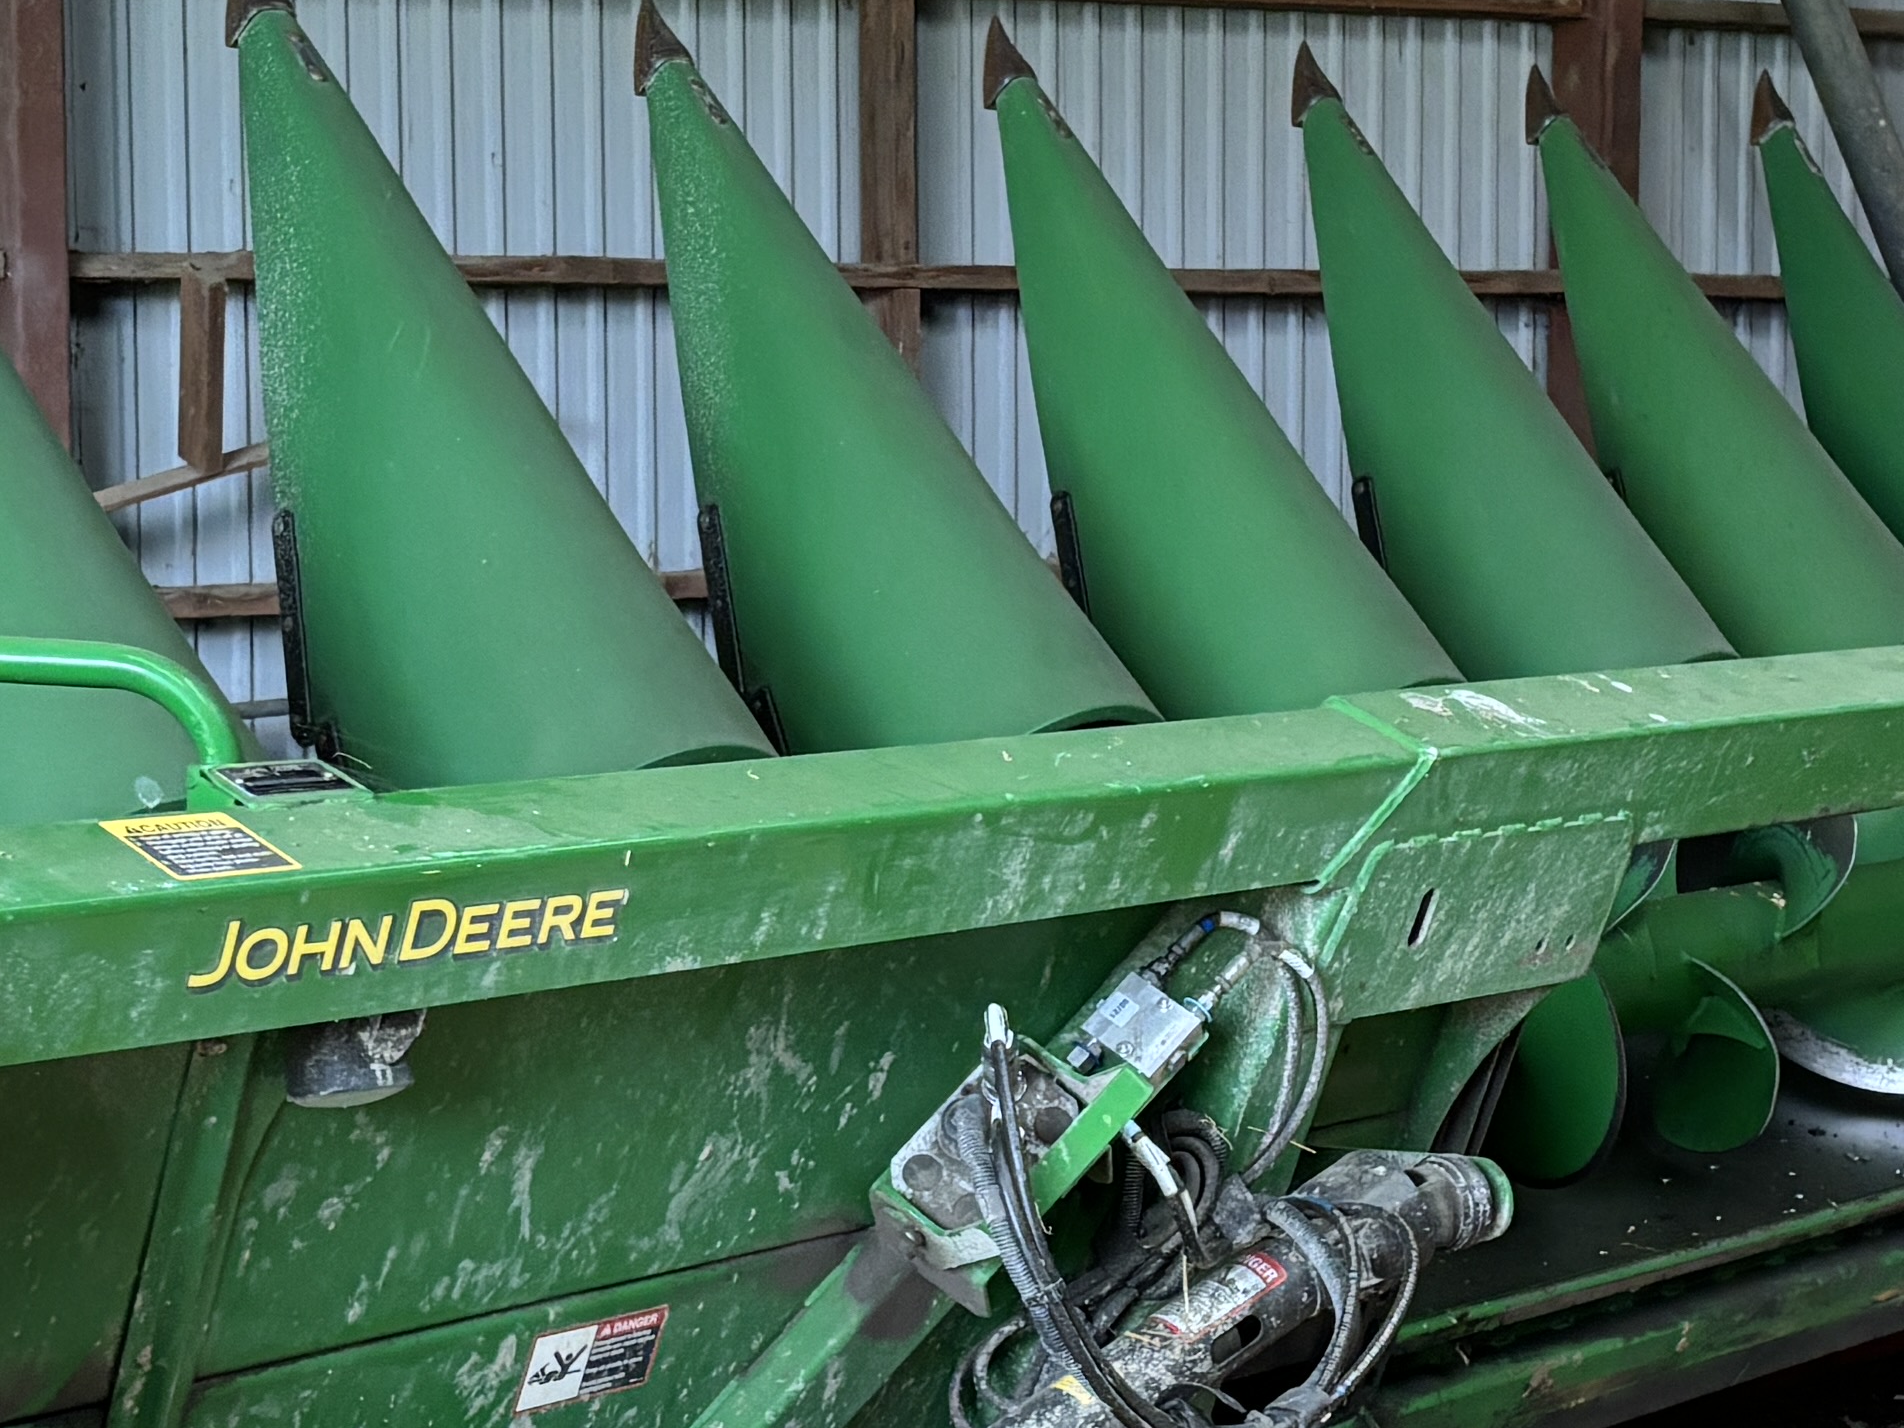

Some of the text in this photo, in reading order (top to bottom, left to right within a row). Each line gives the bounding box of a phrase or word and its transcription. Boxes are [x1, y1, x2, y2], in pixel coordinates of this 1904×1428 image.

[140, 818, 228, 834] CAUTION
[187, 889, 625, 988] JOHN DEERE
[613, 1313, 659, 1333] DANGER
